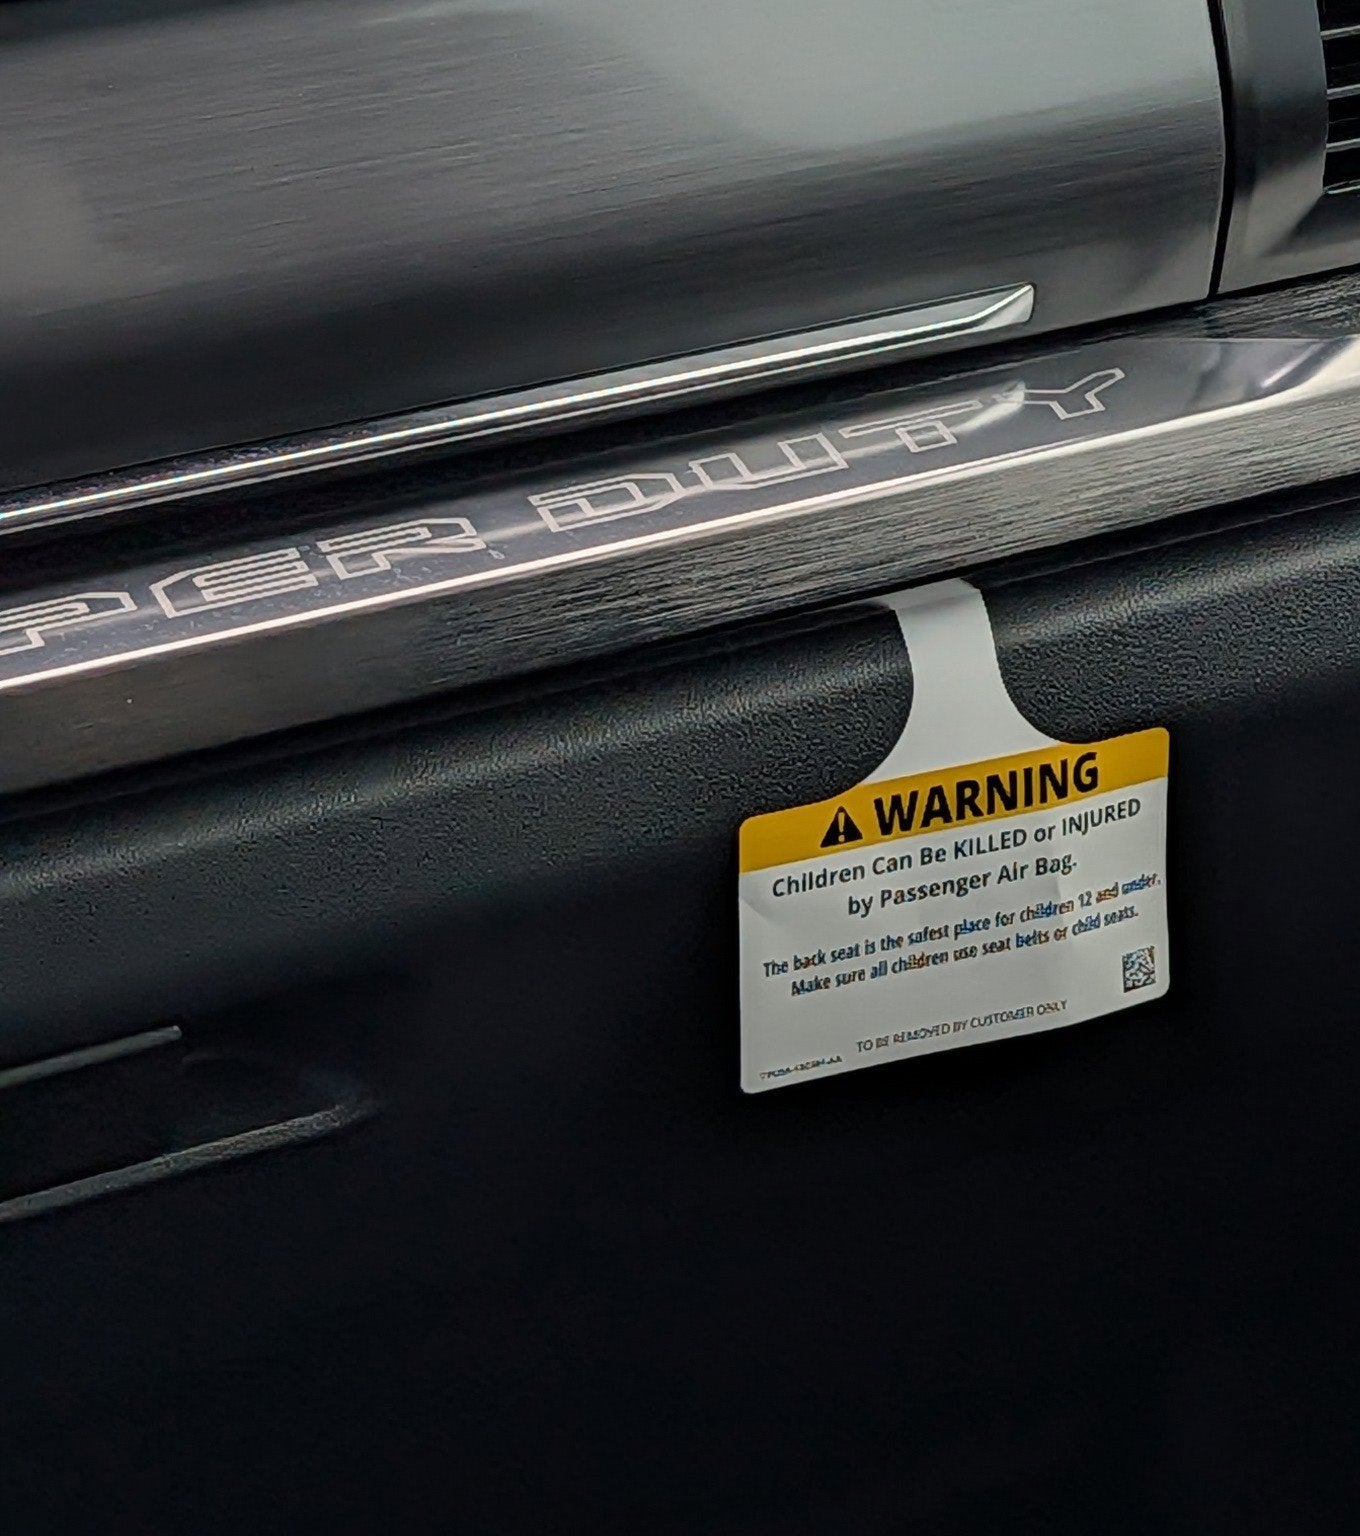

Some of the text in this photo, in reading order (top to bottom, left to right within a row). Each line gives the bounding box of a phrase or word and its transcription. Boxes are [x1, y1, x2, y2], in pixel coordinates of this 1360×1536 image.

[0, 366, 1126, 656] PER DUTY
[873, 751, 1099, 836] WARNING
[772, 798, 1141, 898] Children Can Be KILLED or INJURED
[848, 853, 1077, 919] by Passenger Air Bag.
[763, 959, 789, 978] The
[793, 949, 827, 971] back
[830, 943, 861, 962] seat
[864, 939, 876, 956] is
[880, 935, 904, 952] the
[908, 924, 950, 946] safest
[953, 917, 991, 941] place
[995, 911, 1016, 928] for
[1019, 900, 1075, 923] children
[1078, 891, 1093, 908] 12
[791, 975, 831, 997] Make
[835, 968, 866, 988] sure
[870, 959, 888, 979] all
[891, 951, 949, 975] children
[953, 943, 978, 961] use
[982, 937, 1011, 955] seat
[1015, 928, 1050, 949] belts
[1053, 926, 1068, 942] or
[1072, 912, 1101, 936] child
[855, 1038, 874, 1053] TO
[970, 1005, 1035, 1029] CUSTOMER
